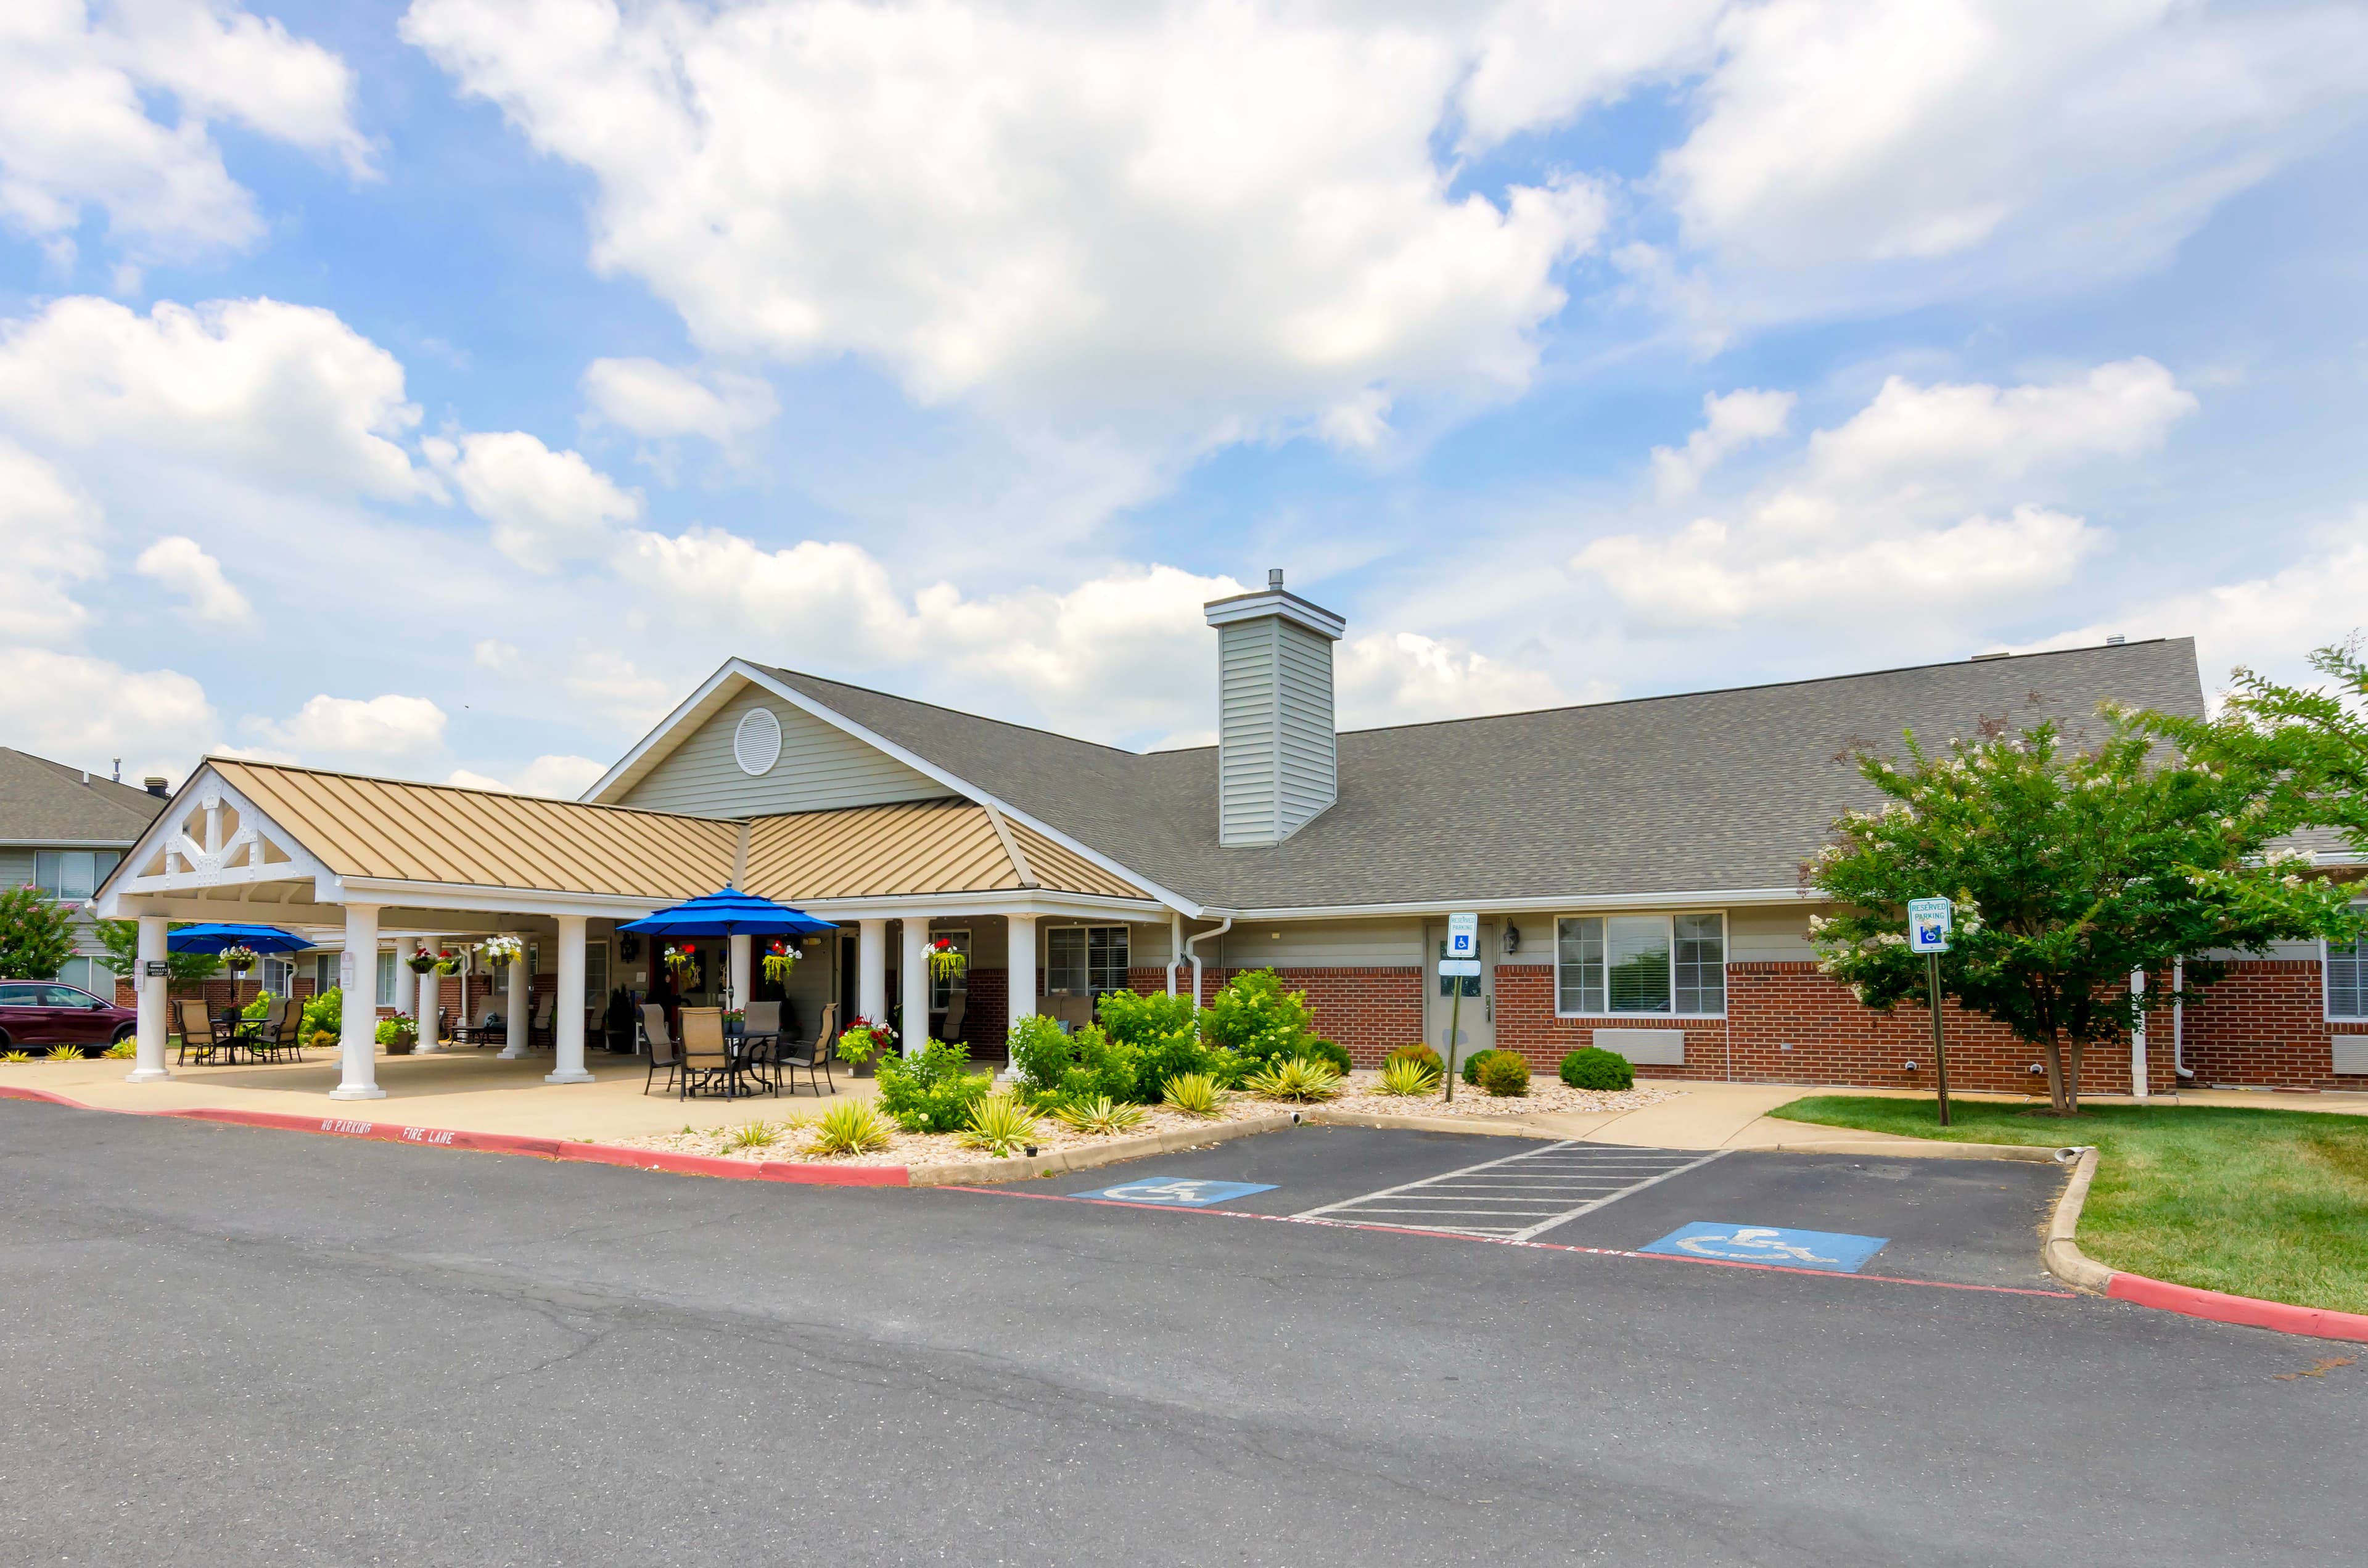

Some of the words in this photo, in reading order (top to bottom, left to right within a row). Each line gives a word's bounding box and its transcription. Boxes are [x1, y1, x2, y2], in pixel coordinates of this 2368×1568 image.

[1912, 903, 1946, 911] RESERVED
[321, 1120, 333, 1130] NO
[334, 1120, 372, 1134] PARKING
[403, 1127, 425, 1141] FIRE
[428, 1130, 455, 1144] LANE
[1565, 1246, 1638, 1257] LANE
